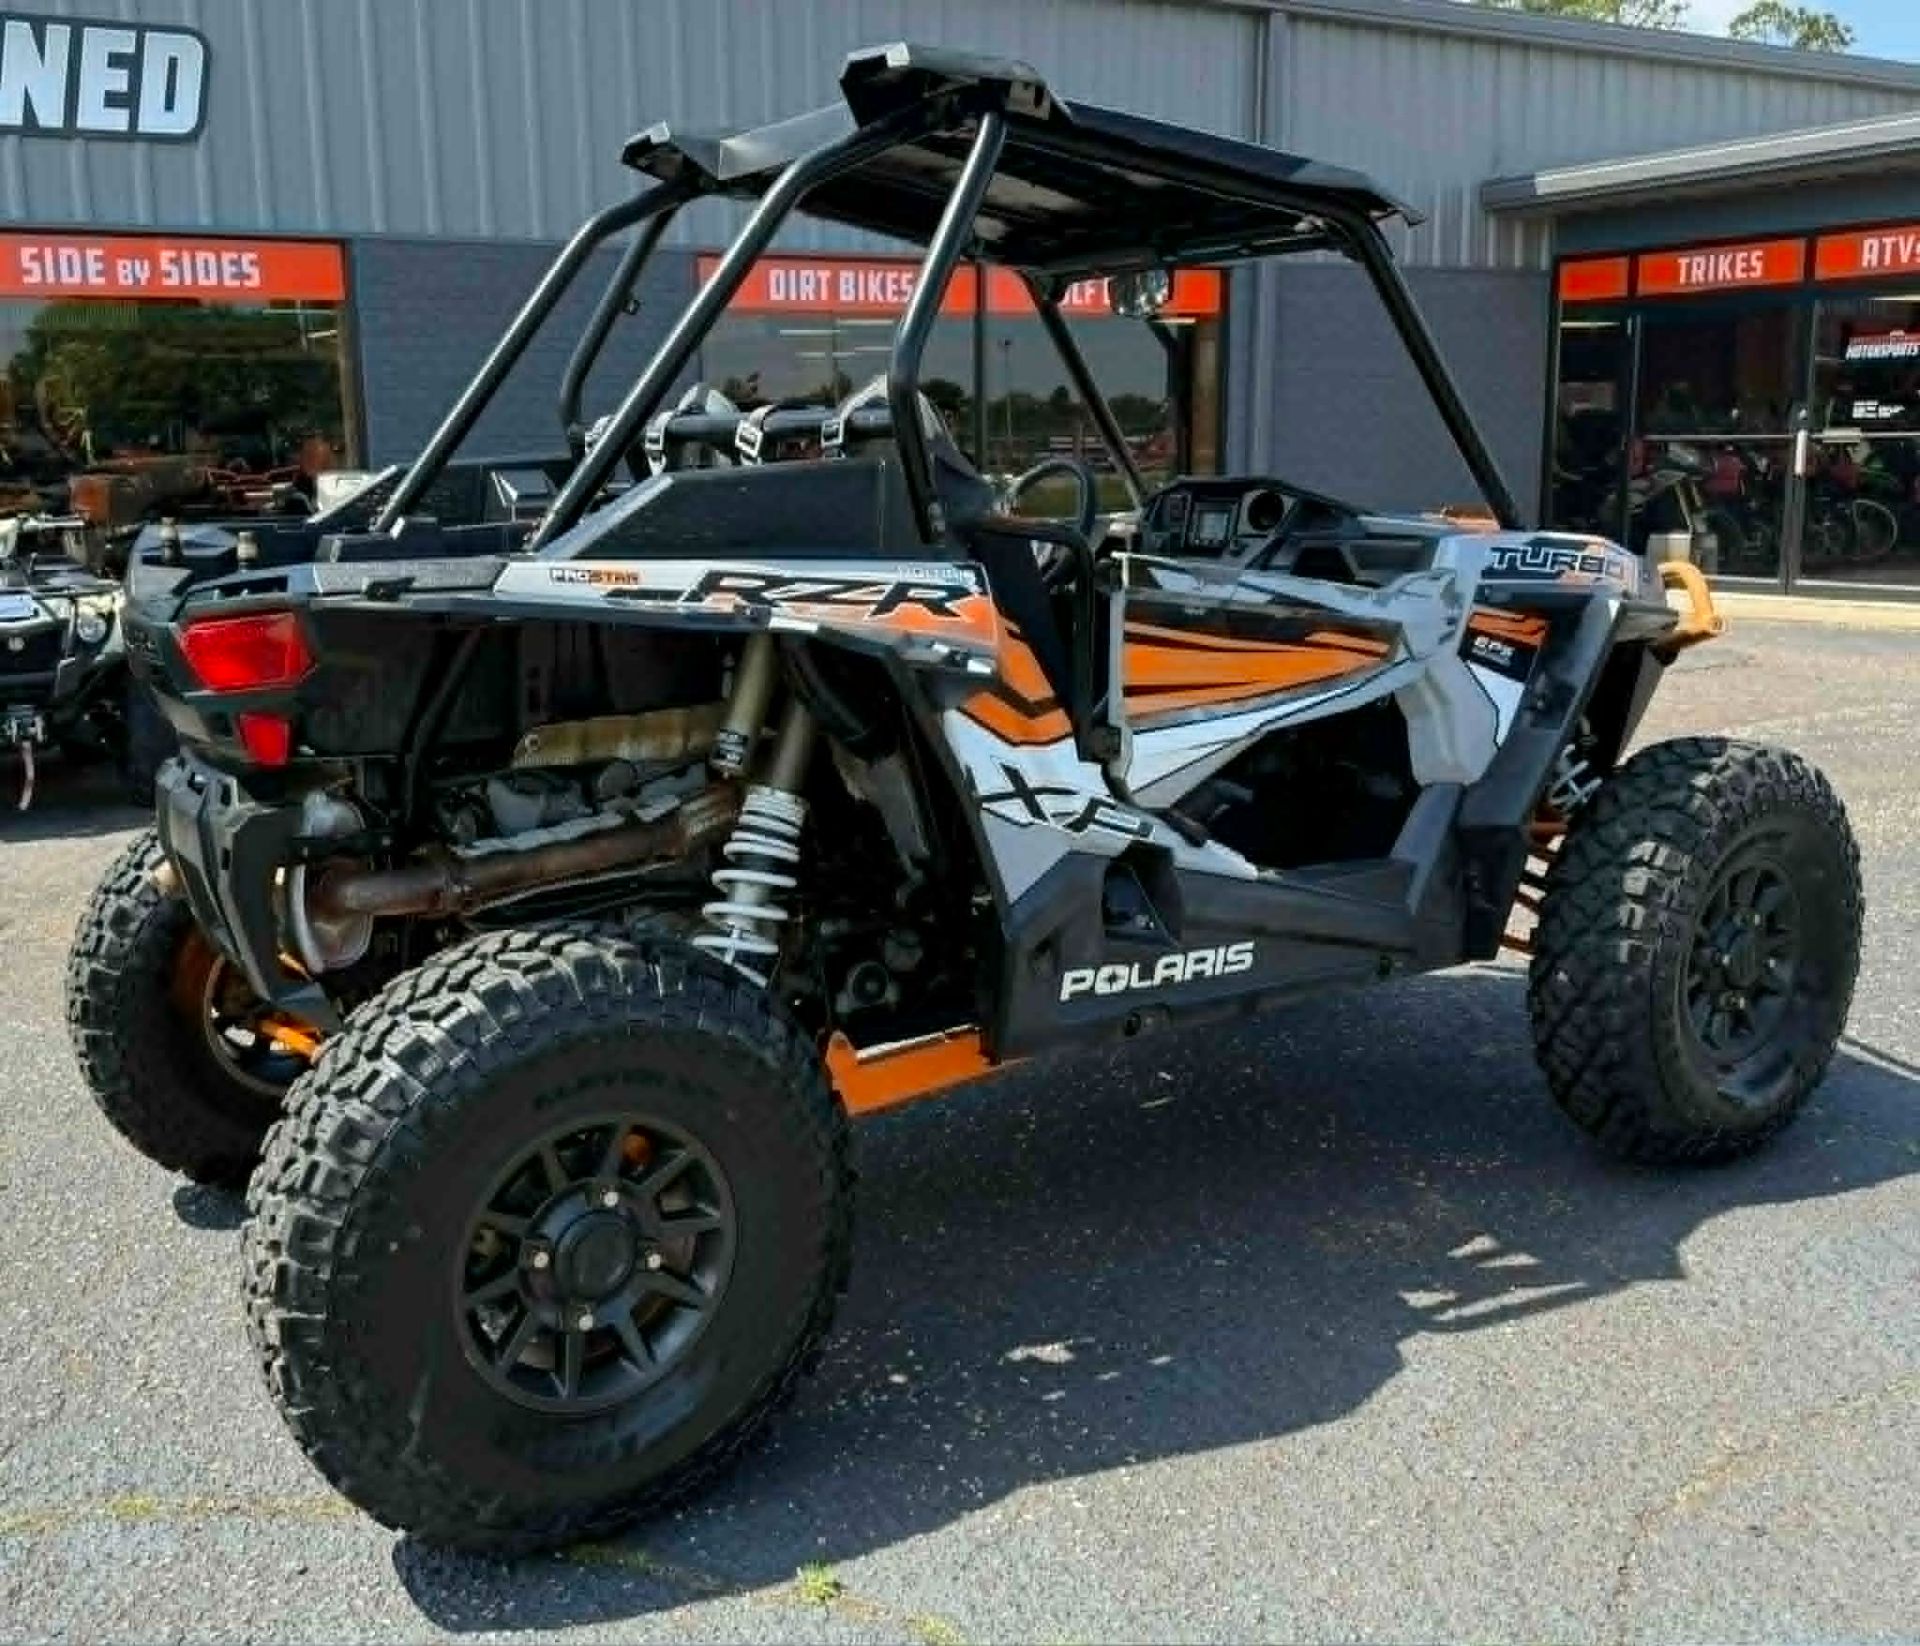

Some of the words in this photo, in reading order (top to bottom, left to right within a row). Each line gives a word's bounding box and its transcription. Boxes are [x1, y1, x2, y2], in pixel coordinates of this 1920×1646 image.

[0, 19, 205, 134] NED
[19, 247, 106, 285] SIDE
[116, 258, 150, 286] BY
[160, 250, 261, 287] SIDES
[769, 269, 832, 301] DIRT
[839, 269, 914, 303] BIKES
[1677, 250, 1764, 284] TRIKES
[1490, 545, 1625, 577] TURBO
[679, 569, 965, 617] RZR
[1060, 941, 1255, 1002] POLARIS
